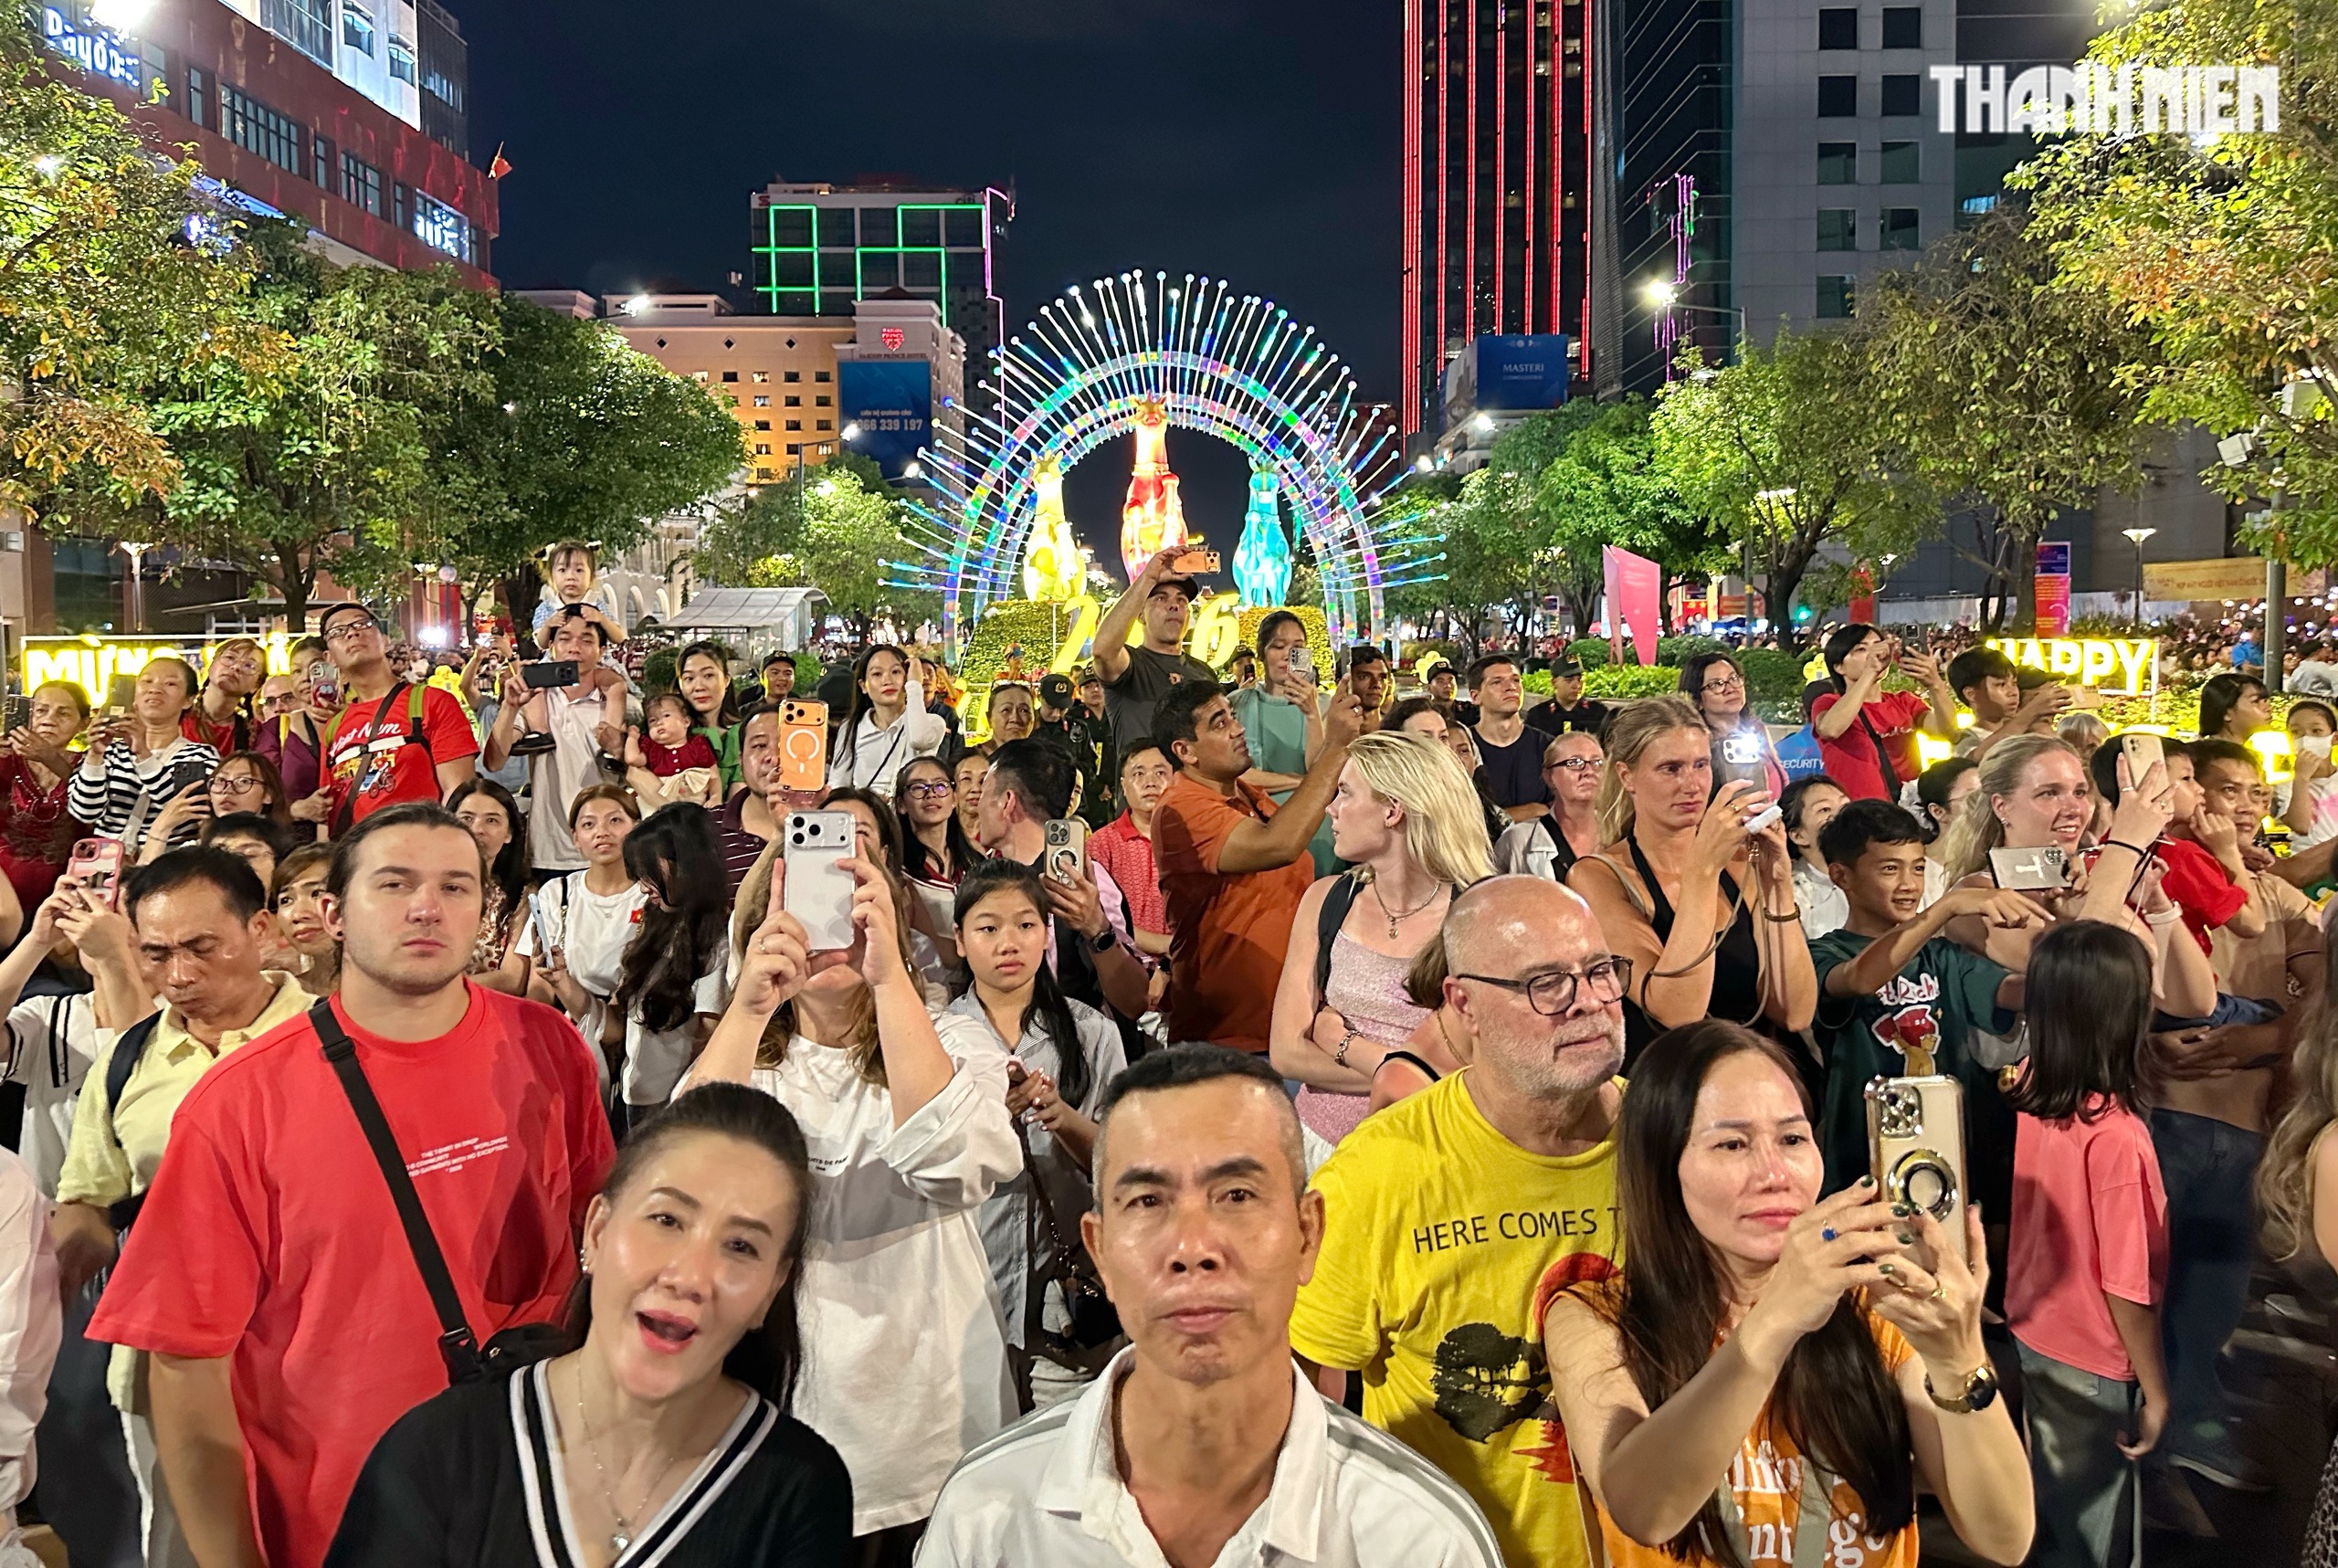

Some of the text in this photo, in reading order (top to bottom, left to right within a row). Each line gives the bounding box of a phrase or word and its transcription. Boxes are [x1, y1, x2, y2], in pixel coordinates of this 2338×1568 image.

[1503, 363, 1544, 373] MASTERI
[879, 418, 900, 431] 339
[903, 418, 923, 431] 197
[1413, 1215, 1490, 1254] HERE
[1499, 1208, 1598, 1239] COMES
